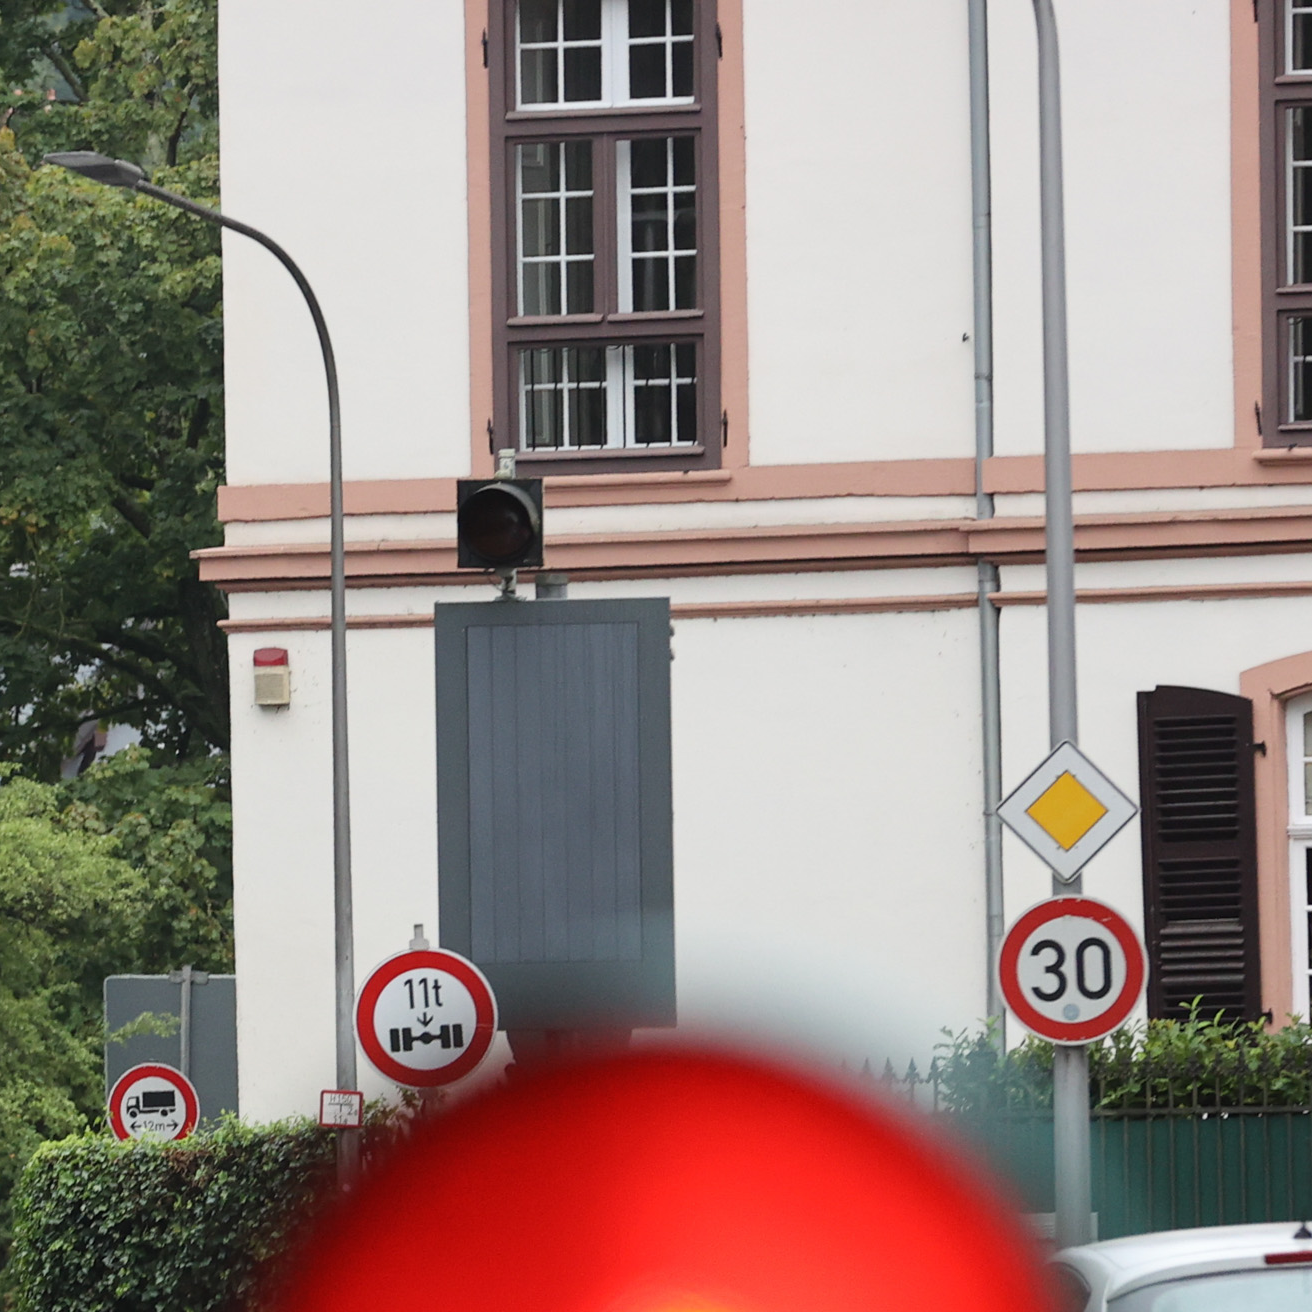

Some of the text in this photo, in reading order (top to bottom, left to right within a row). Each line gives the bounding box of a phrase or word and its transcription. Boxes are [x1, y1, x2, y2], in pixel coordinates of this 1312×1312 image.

[1030, 937, 1112, 1002] 30
[403, 977, 443, 1009] 11t
[143, 1120, 165, 1131] 12m
